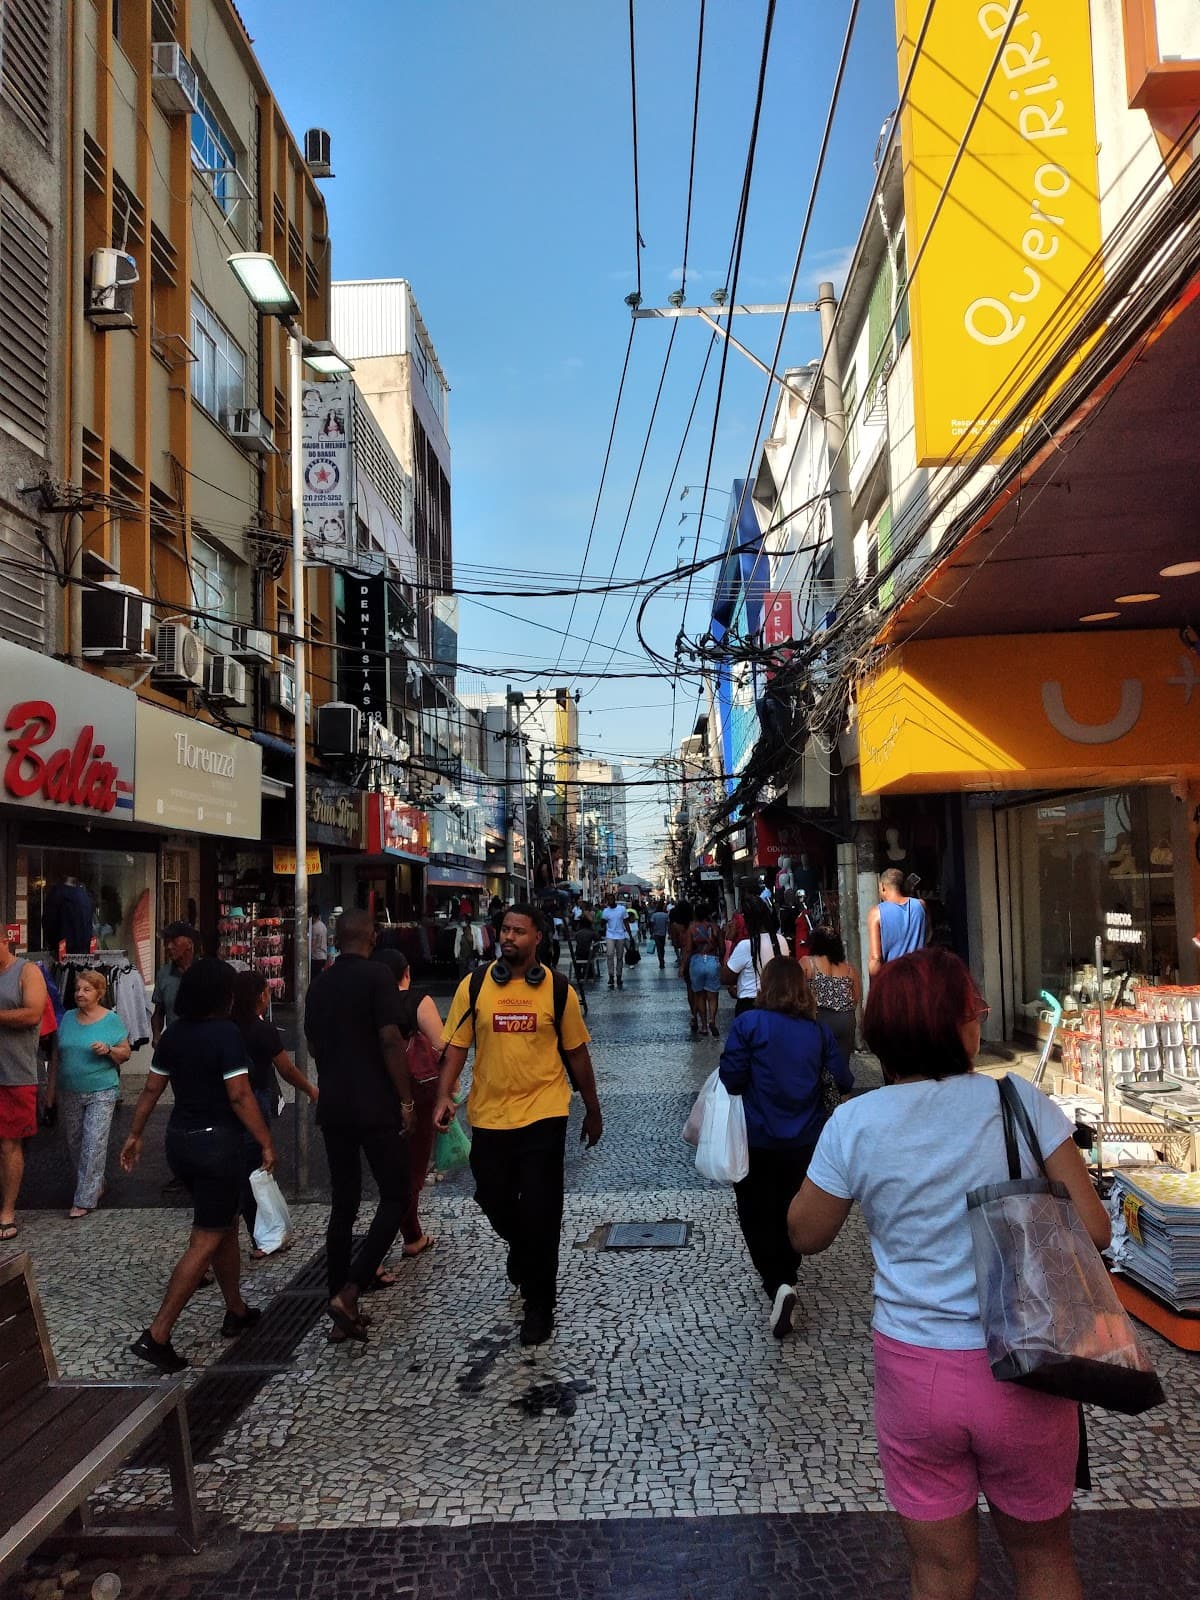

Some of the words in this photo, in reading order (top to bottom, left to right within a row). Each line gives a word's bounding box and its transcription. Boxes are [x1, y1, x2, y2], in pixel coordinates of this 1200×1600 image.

[964, 163, 1070, 345] Quero
[360, 586, 371, 705] DENTISTAS
[175, 732, 235, 779] Florenzza
